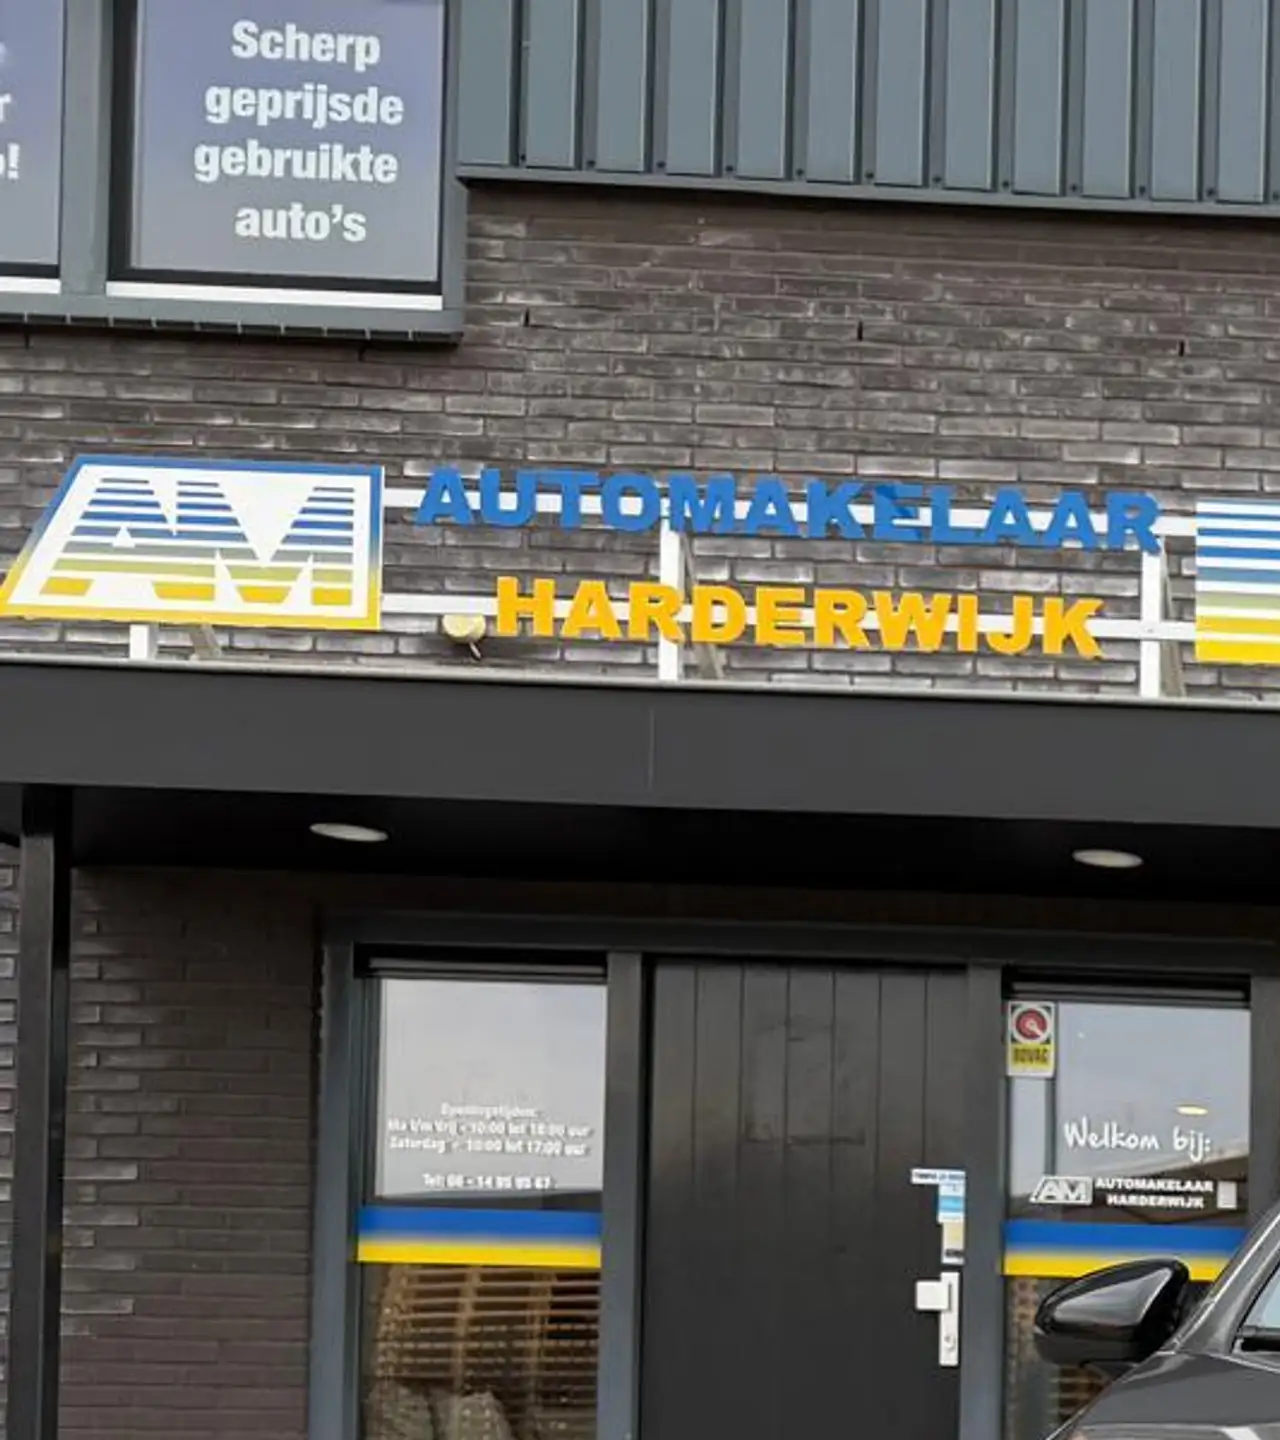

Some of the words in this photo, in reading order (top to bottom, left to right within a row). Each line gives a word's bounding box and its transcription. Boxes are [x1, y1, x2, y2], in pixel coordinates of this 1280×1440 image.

[231, 20, 380, 72] Scherp
[205, 83, 404, 129] geprijsde
[194, 139, 398, 183] gebruikte
[235, 203, 366, 242] auto's
[415, 467, 1162, 553] AUTOMAKELAAR
[40, 477, 354, 605] AM
[496, 576, 1104, 658] HARDERWIJK
[1064, 1116, 1160, 1149] Welkom
[1173, 1125, 1211, 1162] bij:
[1095, 1178, 1214, 1192] AUTOMAKELAAR
[1106, 1194, 1204, 1208] HARDERWIJK
